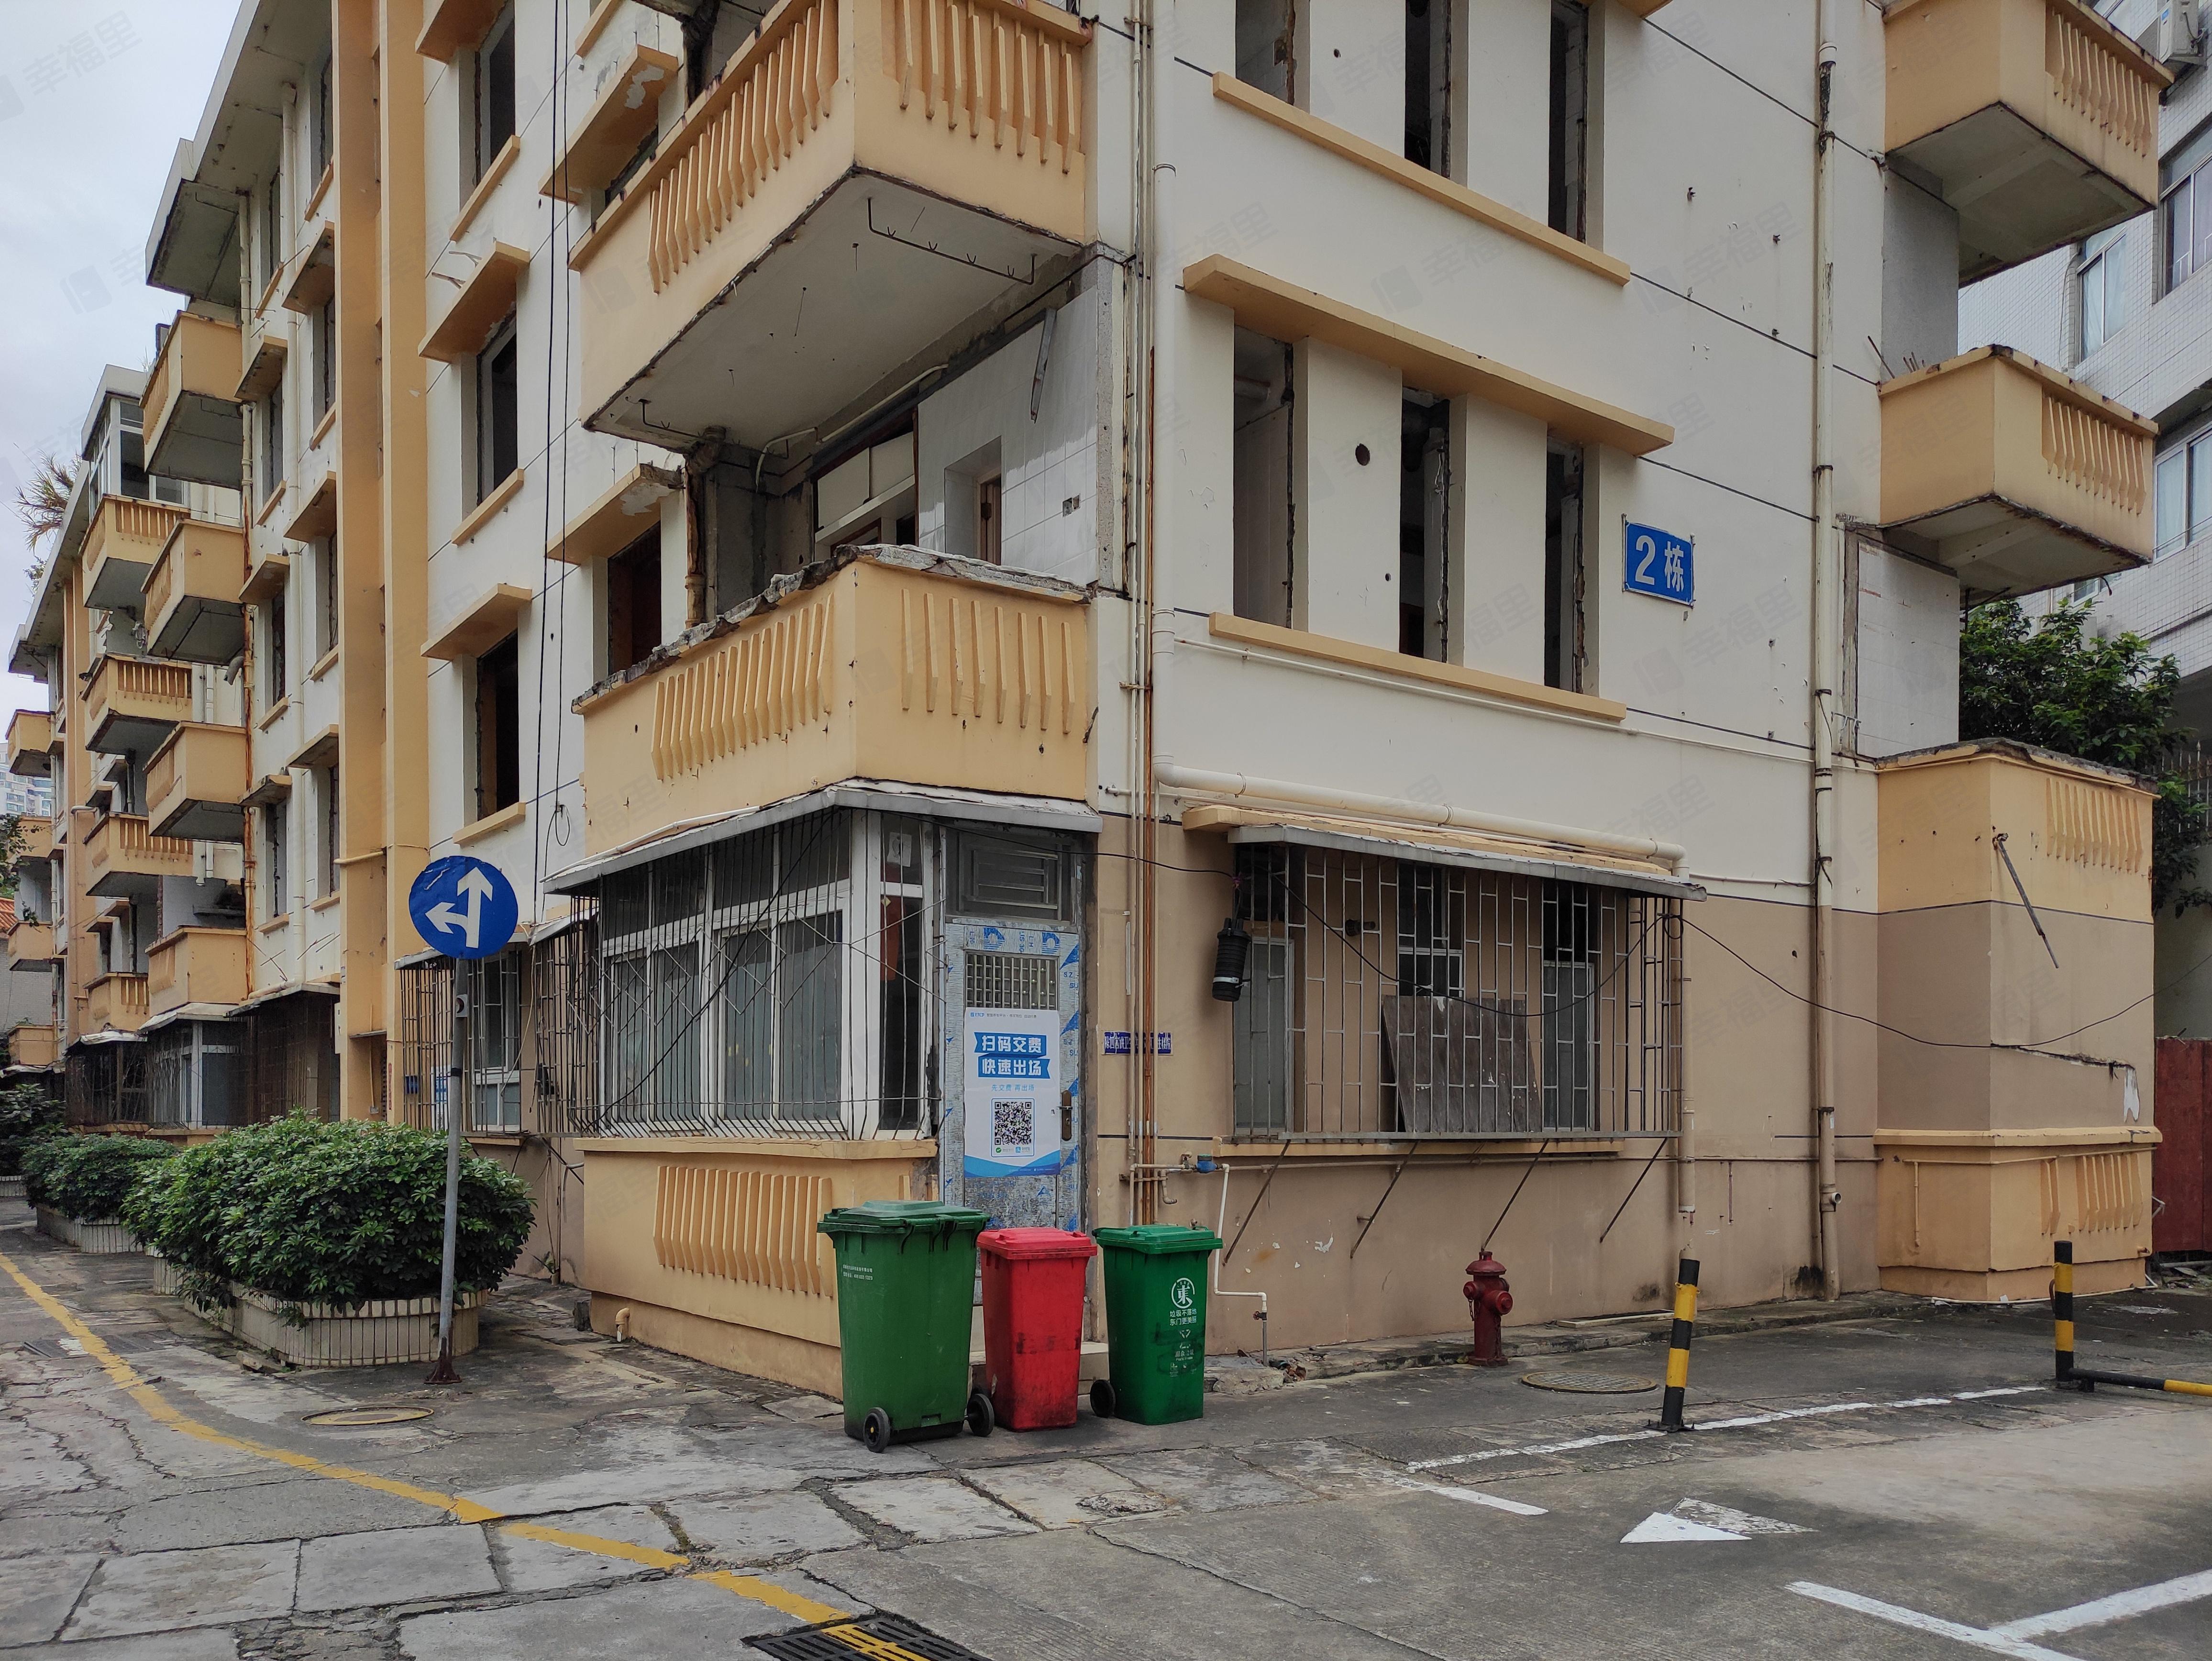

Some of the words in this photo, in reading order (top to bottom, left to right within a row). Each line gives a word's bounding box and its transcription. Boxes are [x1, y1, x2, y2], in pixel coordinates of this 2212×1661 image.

[1635, 535, 1684, 592] 2栋
[982, 1035, 1041, 1053] 扫码交费
[982, 1058, 1042, 1076] 快速出场
[1170, 1308, 1197, 1318] 垃圾不落地
[1170, 1316, 1197, 1326] 东门更美丽
